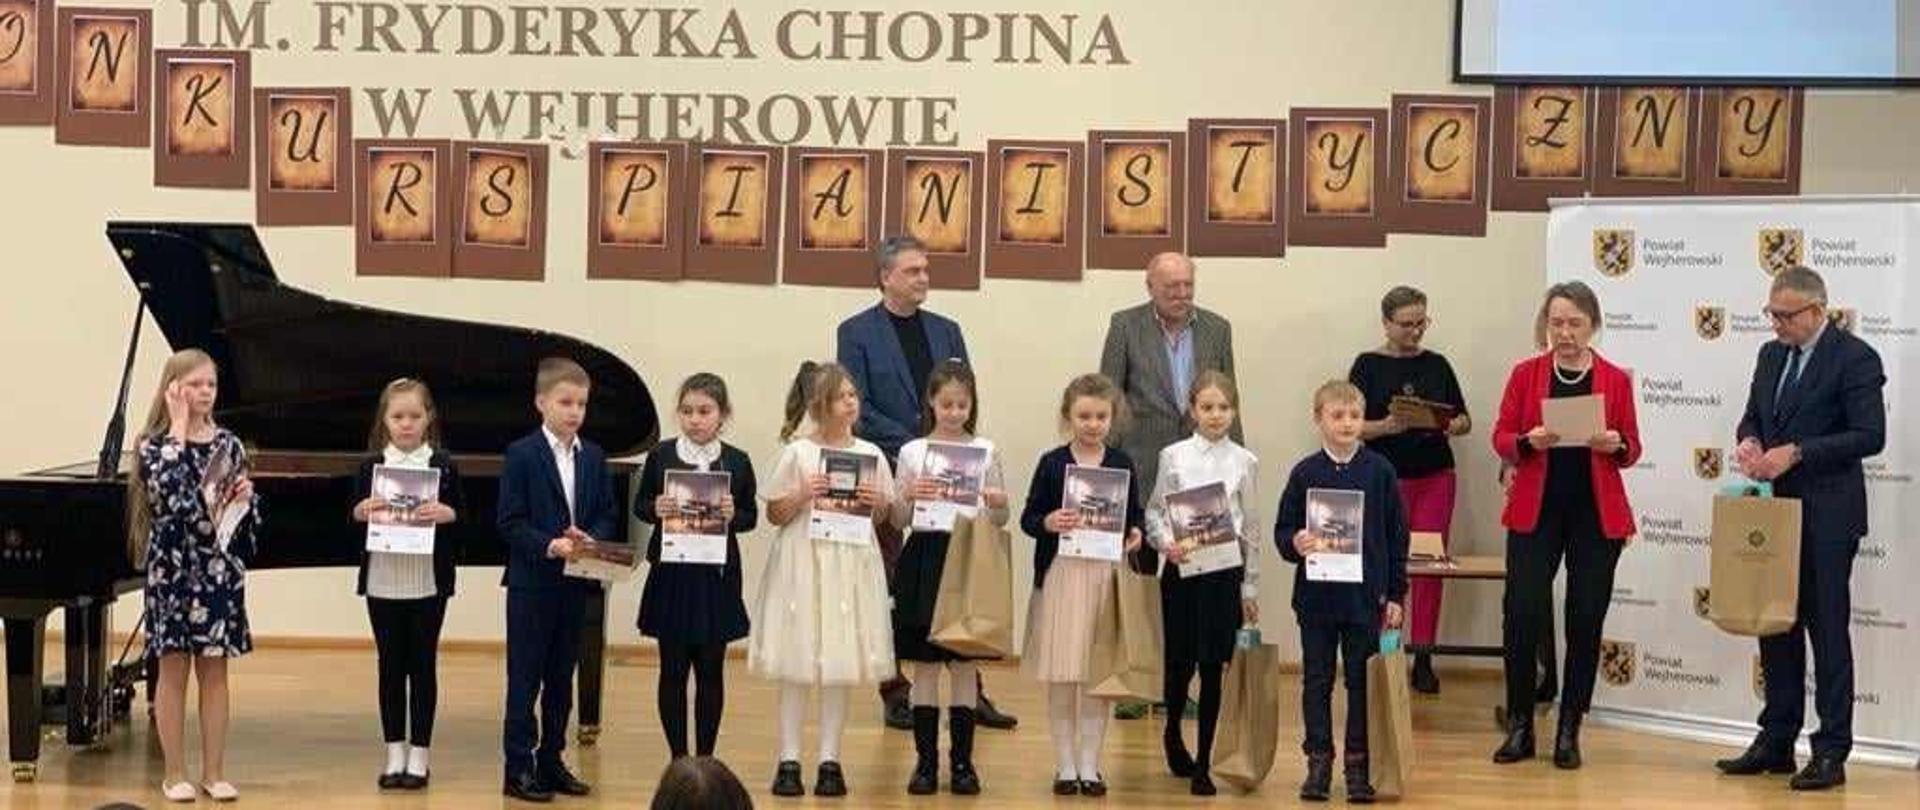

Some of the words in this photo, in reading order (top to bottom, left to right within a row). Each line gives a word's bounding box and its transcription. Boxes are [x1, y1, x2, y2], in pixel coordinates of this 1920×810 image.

[181, 0, 290, 51] IM.
[313, 1, 757, 59] FRYDERYKA
[776, 9, 1131, 65] CHOPINA
[363, 88, 432, 138] W
[1642, 238, 1685, 251] Powiat
[1812, 238, 1856, 251] Powiat
[1642, 253, 1723, 268] Wejherowski
[1812, 253, 1895, 268] Wejherowski
[1642, 377, 1683, 391] Powiat
[1642, 393, 1722, 408] Wejherowski
[1641, 516, 1682, 530] Powiat
[1643, 653, 1683, 668] Powiat
[1644, 669, 1722, 685] Wejherowski
